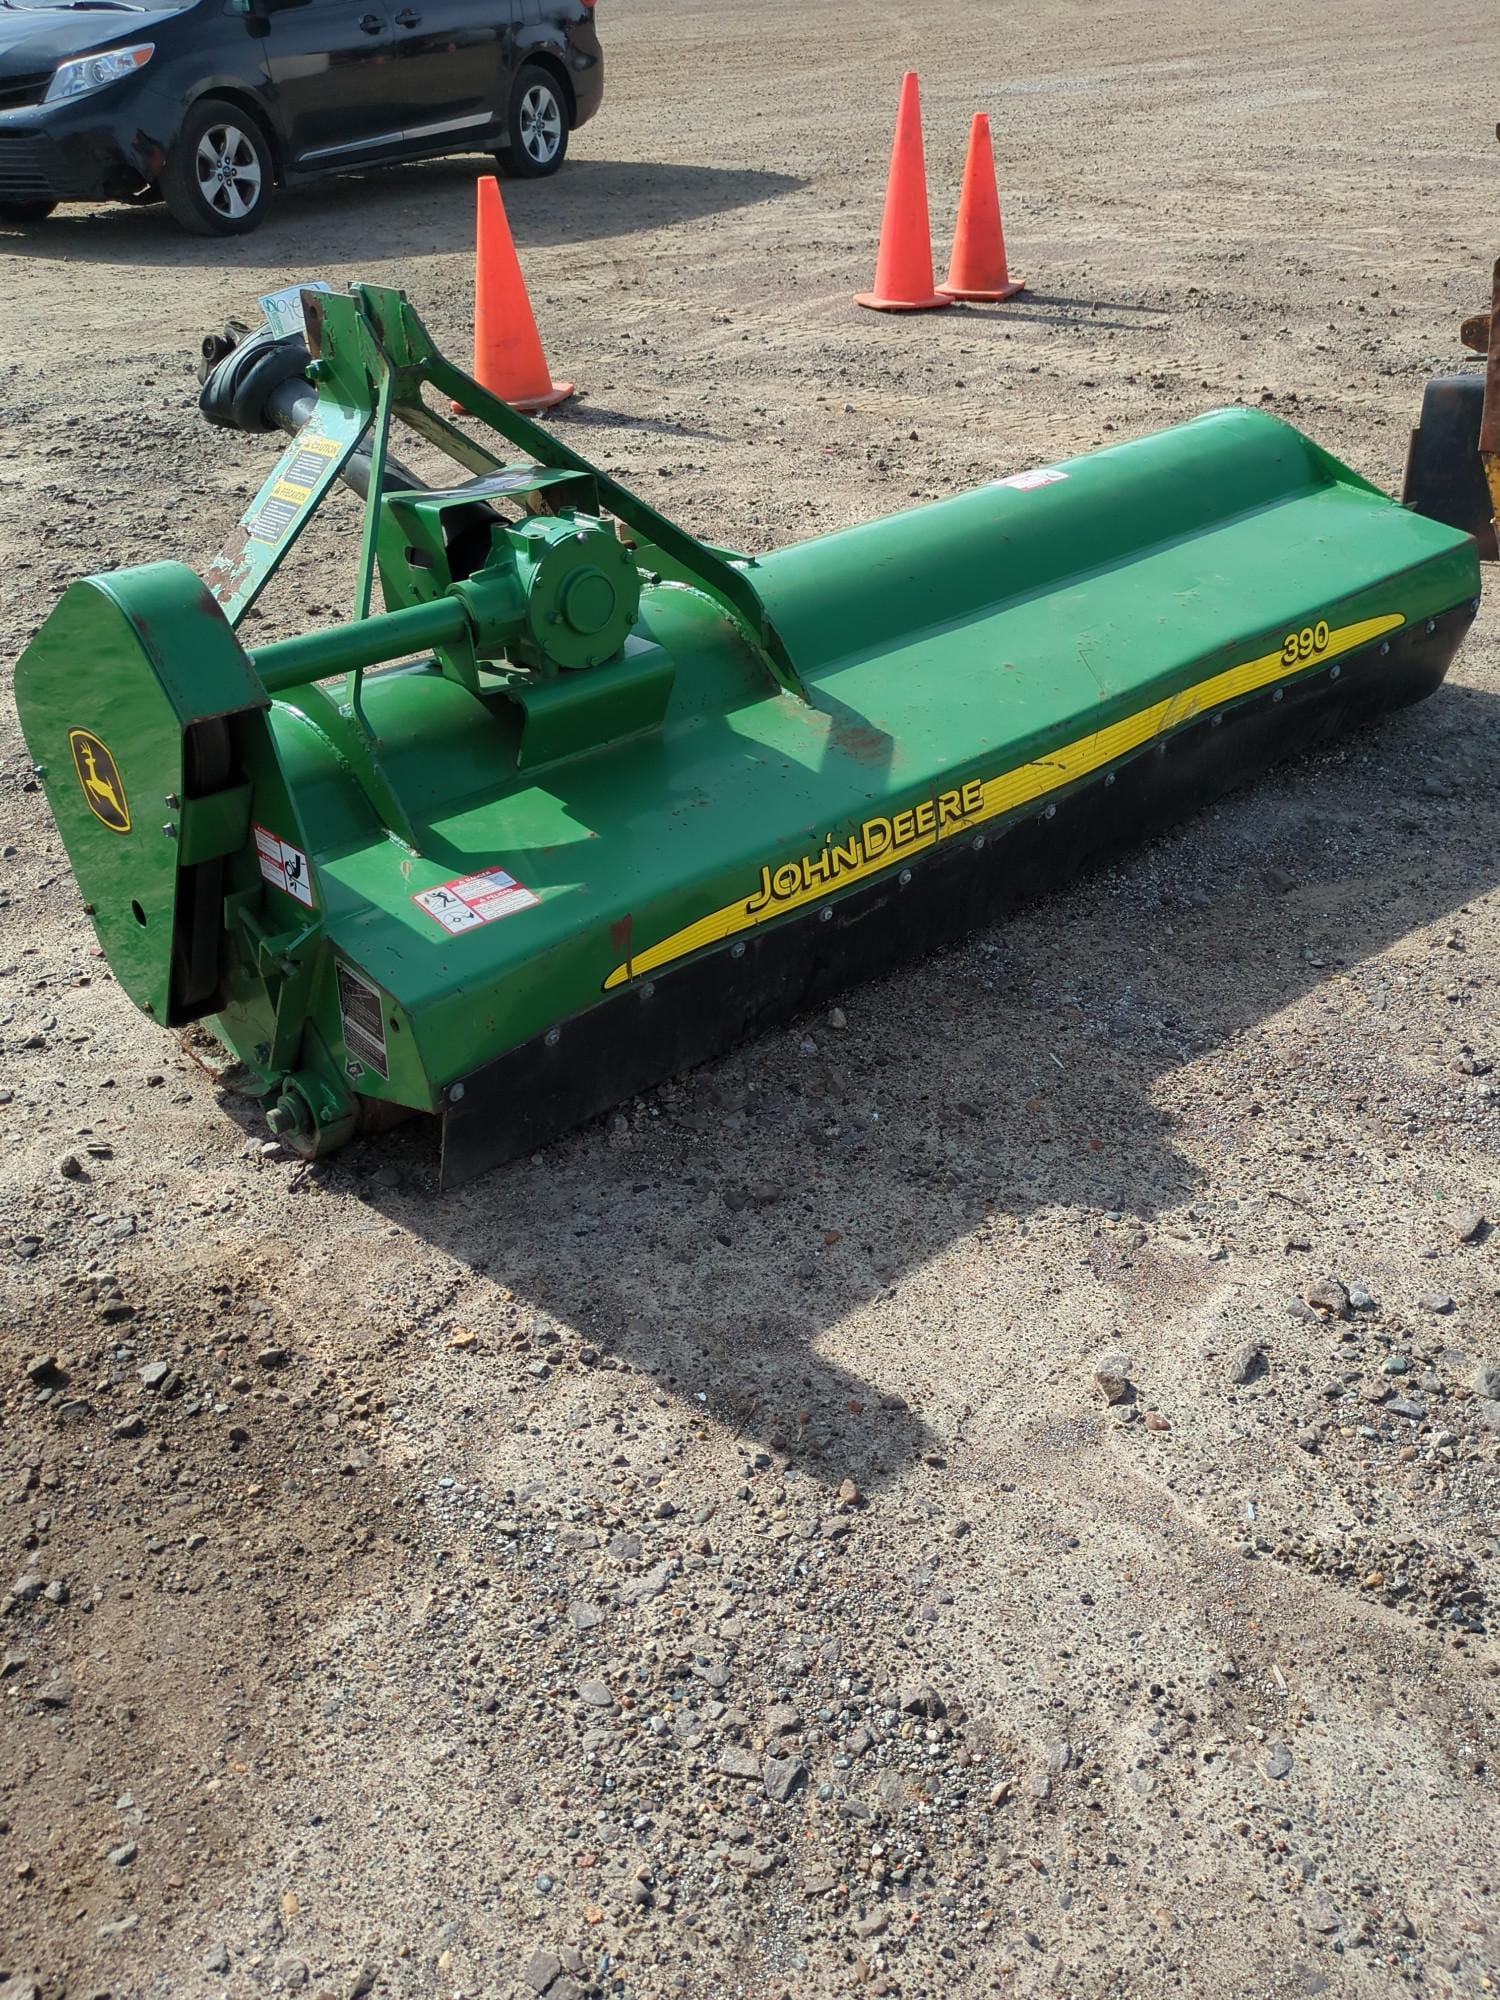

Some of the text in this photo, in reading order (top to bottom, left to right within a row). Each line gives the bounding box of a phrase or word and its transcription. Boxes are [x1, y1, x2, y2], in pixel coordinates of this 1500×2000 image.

[1281, 619, 1330, 667] 390
[745, 778, 985, 913] JOHN DEERE
